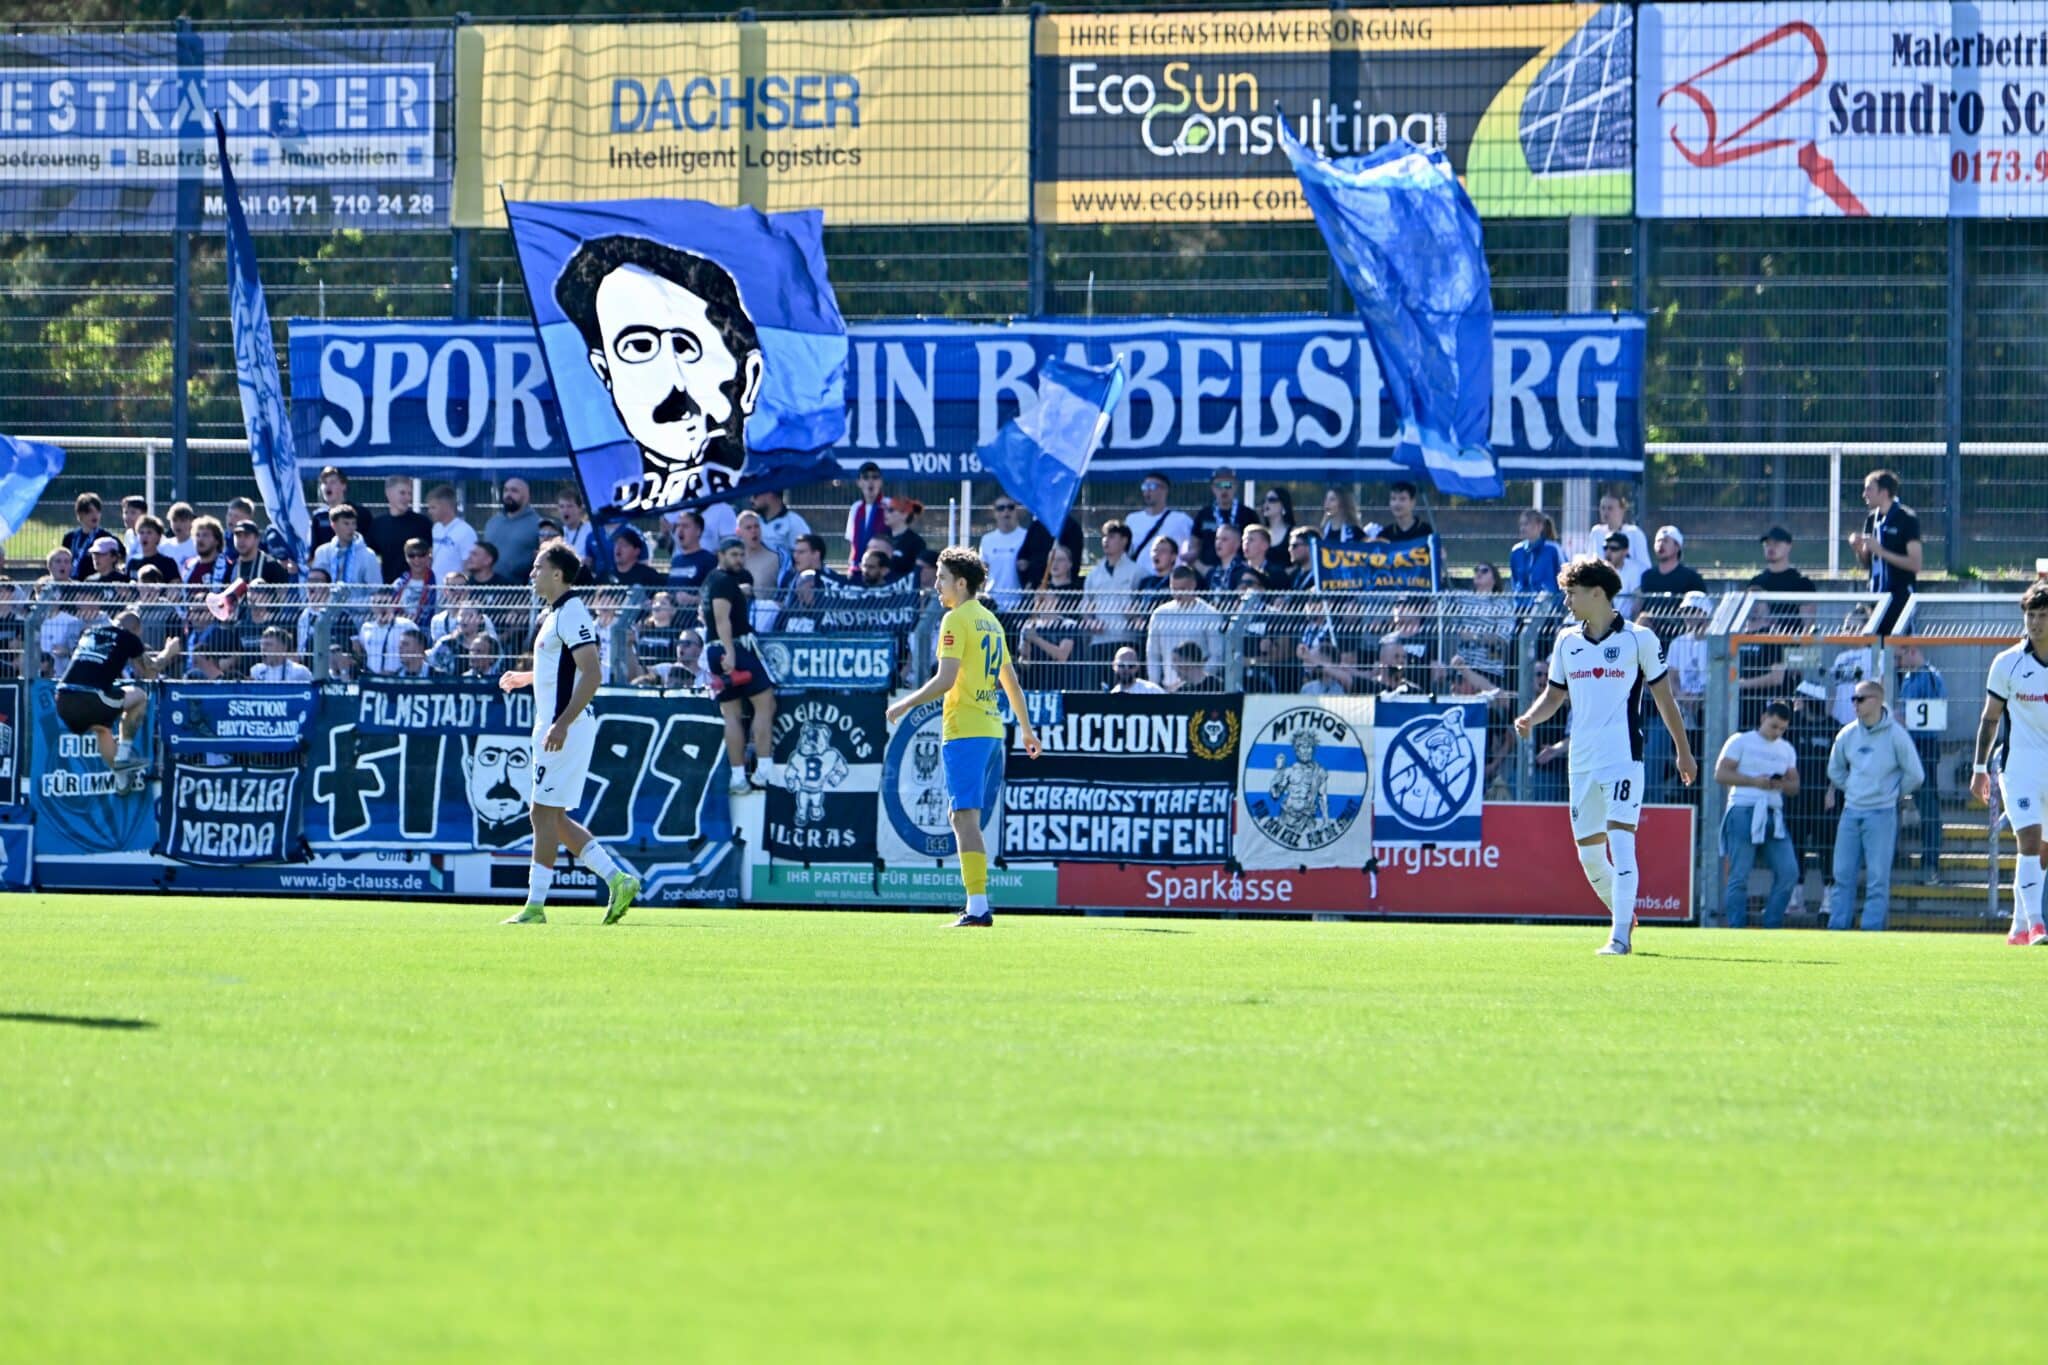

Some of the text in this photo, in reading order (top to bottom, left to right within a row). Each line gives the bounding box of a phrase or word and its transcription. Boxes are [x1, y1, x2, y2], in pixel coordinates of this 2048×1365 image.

[1070, 18, 1433, 46] IHRE EIGENSTROMVERSORGUNG
[1892, 31, 2048, 68] Malerbetri
[1068, 62, 1258, 116] EcoSun
[610, 74, 860, 134] DACHSER
[1829, 81, 2046, 136] Sandro Sc
[281, 147, 397, 166] Immobilien
[609, 143, 861, 174] Intelligent Logistics
[1951, 149, 2048, 184] 0173.9
[204, 195, 434, 215] Mbil 0171 710 24 28
[910, 452, 951, 473] VON
[792, 647, 890, 678] CHICOS
[981, 634, 1003, 690] 14
[1604, 668, 1625, 678] Liebe
[228, 700, 288, 717] SEKTION
[360, 690, 493, 728] FILMSTADT
[1916, 705, 1929, 728] 9
[217, 720, 300, 737] HINTERLAND
[772, 701, 873, 759] NDERDOGS
[1272, 710, 1348, 742] MYTHOS
[806, 755, 822, 781] B
[42, 769, 80, 797] FÜR
[179, 776, 287, 813] POLIZIA
[1613, 778, 1631, 802] 18
[1005, 786, 1228, 814] VERBANDSSTRAFEN
[181, 819, 276, 857] MERDA
[1005, 814, 1225, 855] ABSCHAFFEN!
[279, 872, 423, 891] www.igb-clauss.de
[786, 871, 809, 884] IHR
[881, 870, 908, 885] FÜR
[1146, 870, 1293, 907] Sparkasse
[663, 885, 739, 901] babelsberg 03
